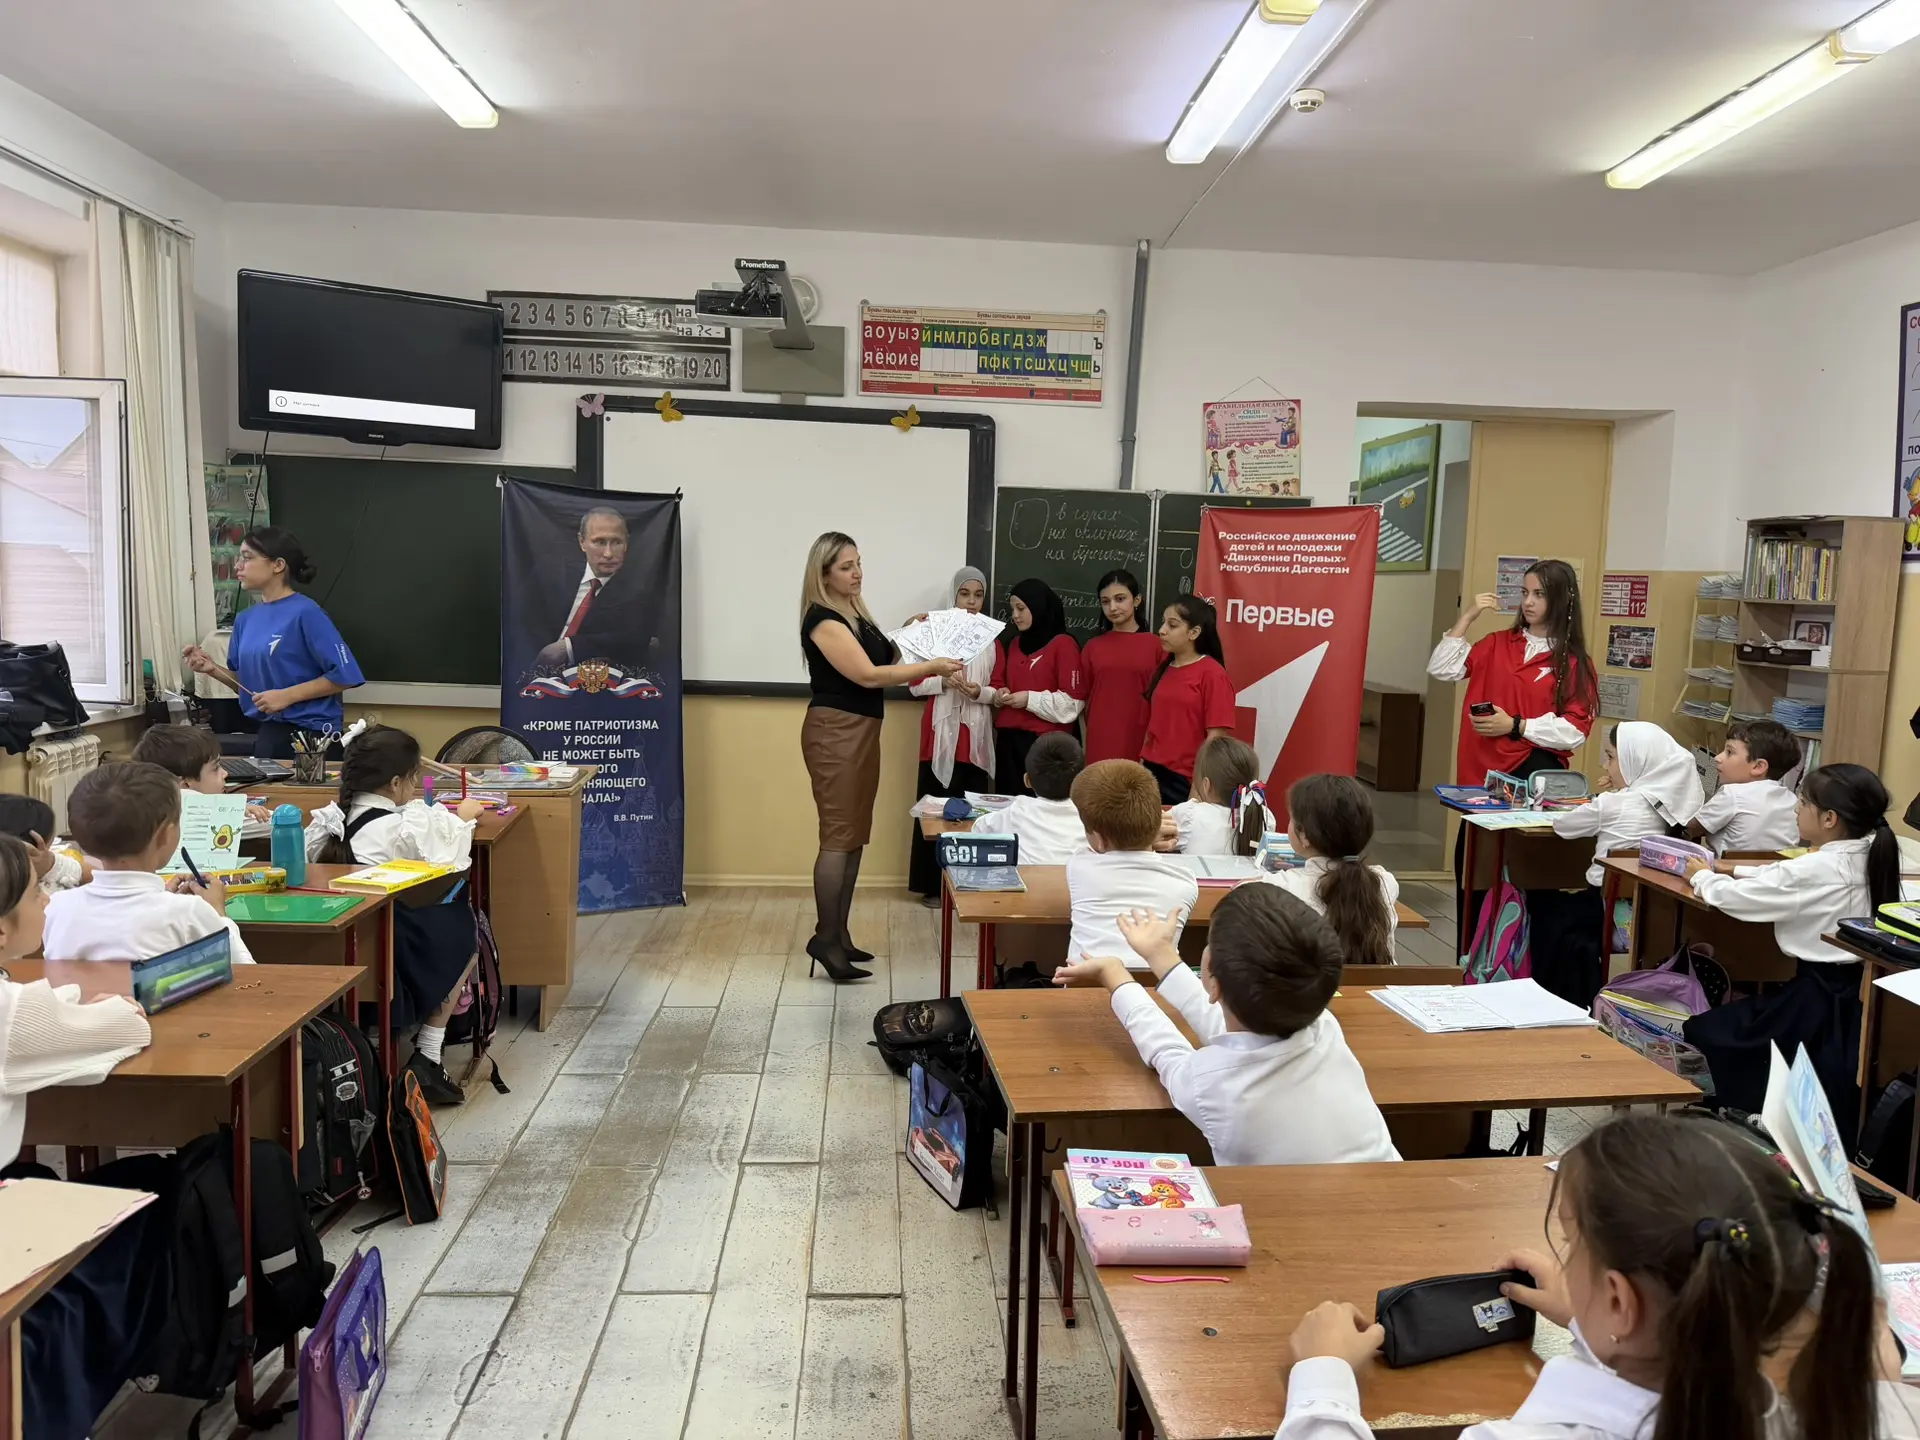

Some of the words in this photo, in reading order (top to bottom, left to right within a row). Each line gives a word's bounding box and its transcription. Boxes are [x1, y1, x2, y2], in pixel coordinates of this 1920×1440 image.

[740, 259, 780, 269] Promethean
[510, 302, 521, 325] 2
[527, 302, 538, 326] 3
[544, 303, 556, 326] 4
[564, 304, 575, 327] 5
[583, 305, 593, 328] 6
[600, 305, 611, 328] 7
[520, 349, 538, 371] 12
[542, 350, 560, 373] 13
[565, 351, 582, 374] 14
[587, 352, 605, 376] 15
[681, 356, 698, 379] 19
[703, 357, 722, 379] 20
[1218, 531, 1291, 541] Российское
[1291, 532, 1357, 542] движение
[1229, 542, 1265, 552] детей
[1276, 544, 1342, 553] молодежи
[1223, 552, 1291, 563] «Движение
[1292, 553, 1347, 564] Первых»
[1219, 562, 1290, 573] Республики
[1291, 564, 1350, 575] Дагестан
[1629, 601, 1646, 615] 112
[1225, 598, 1335, 632] Первые
[522, 720, 572, 731] «КРОМЕ
[575, 719, 660, 731] ПАТРИОТИЗМА
[563, 735, 571, 746] У
[574, 735, 621, 745] РОССИИ
[542, 750, 559, 761] НЕ
[562, 749, 606, 760] МОЖЕТ
[608, 749, 641, 759] БЫТЬ
[613, 814, 629, 822] В.В.
[629, 813, 654, 823] Путин
[945, 845, 978, 864] GO!
